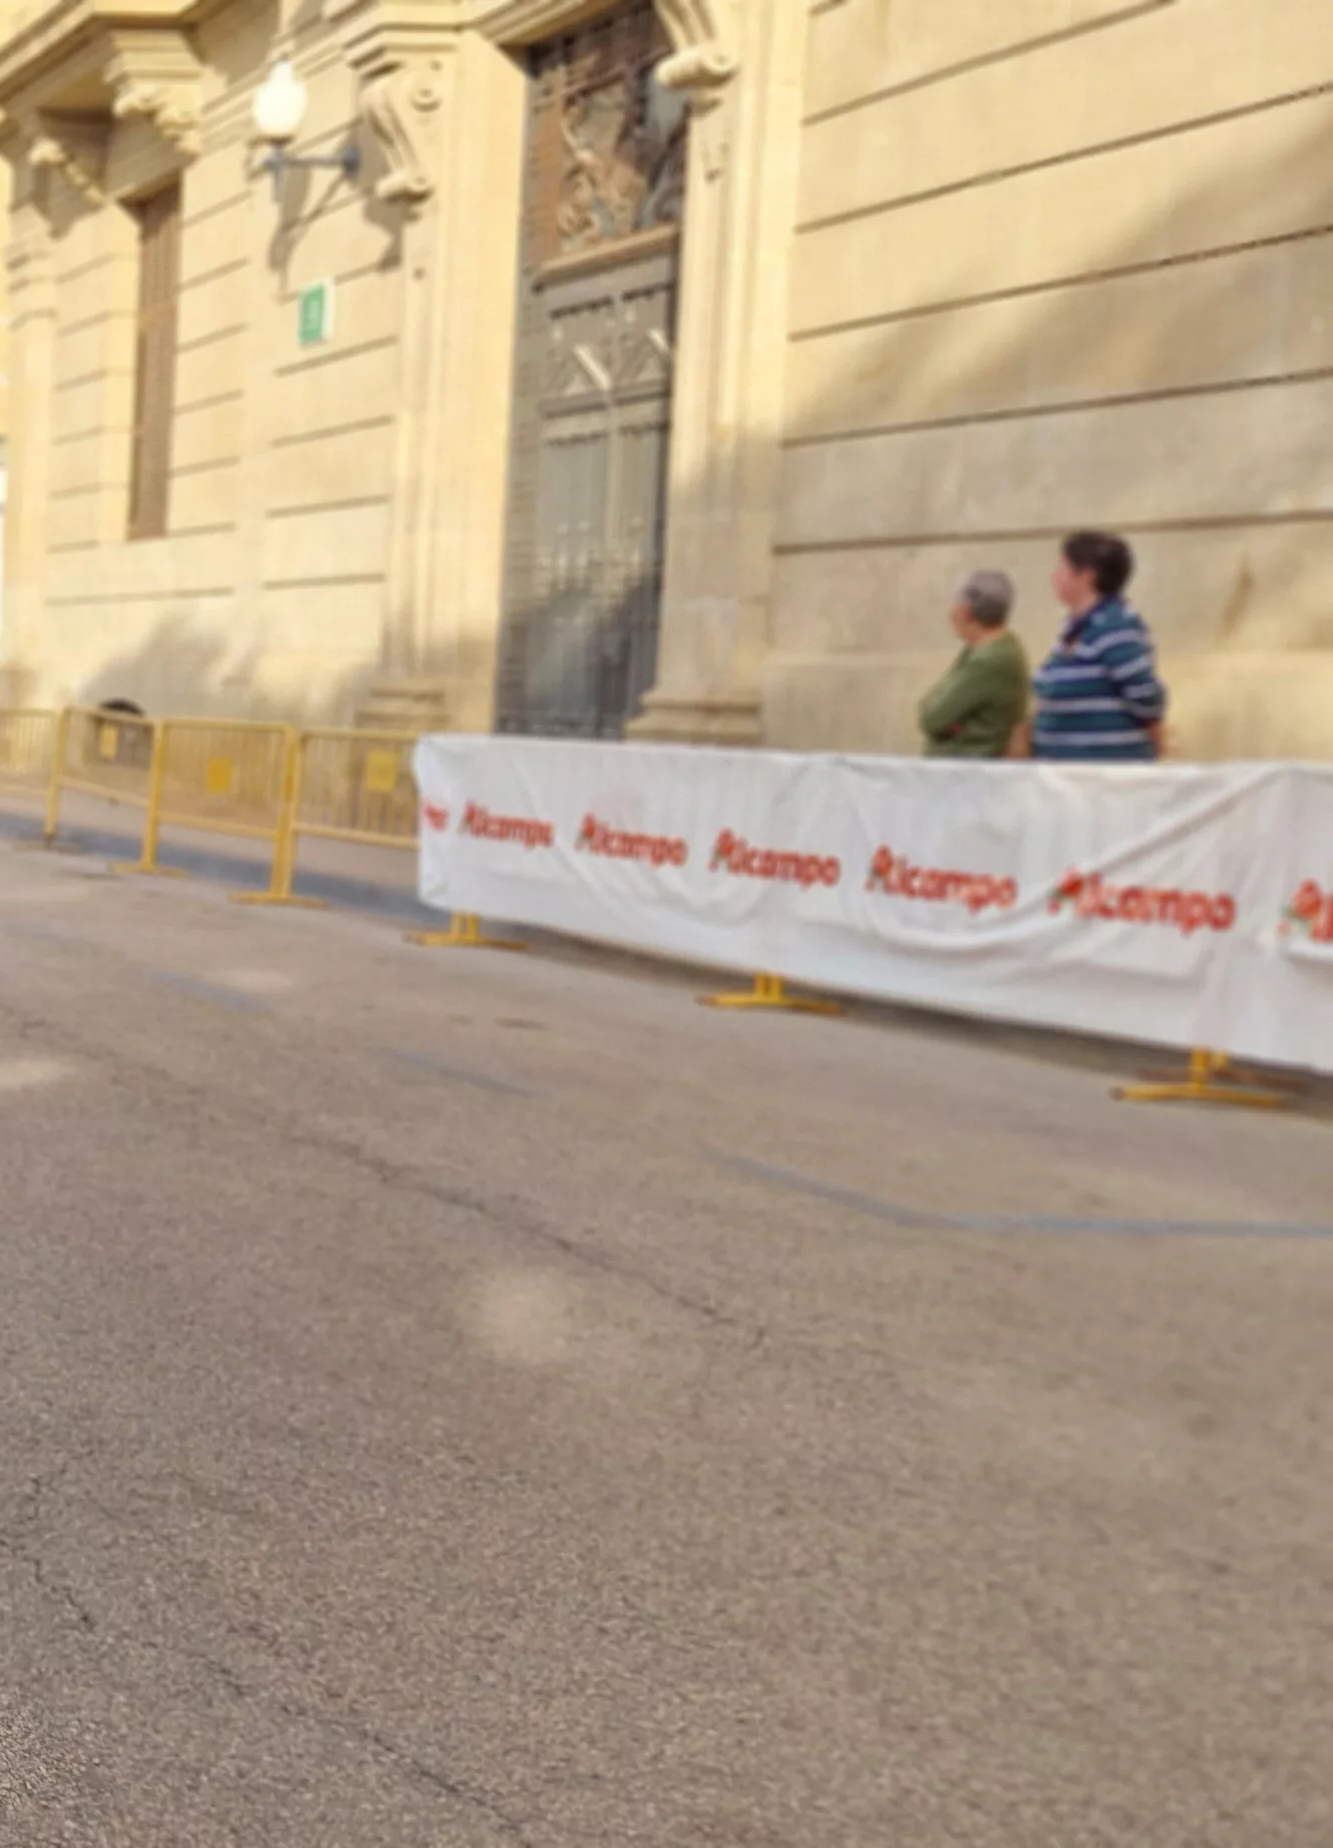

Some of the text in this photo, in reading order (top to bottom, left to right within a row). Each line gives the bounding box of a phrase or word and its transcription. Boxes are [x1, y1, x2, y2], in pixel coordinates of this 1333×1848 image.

[575, 812, 689, 868] Alcampo
[708, 828, 842, 890] Alcampo
[864, 844, 1018, 915] Alcampo
